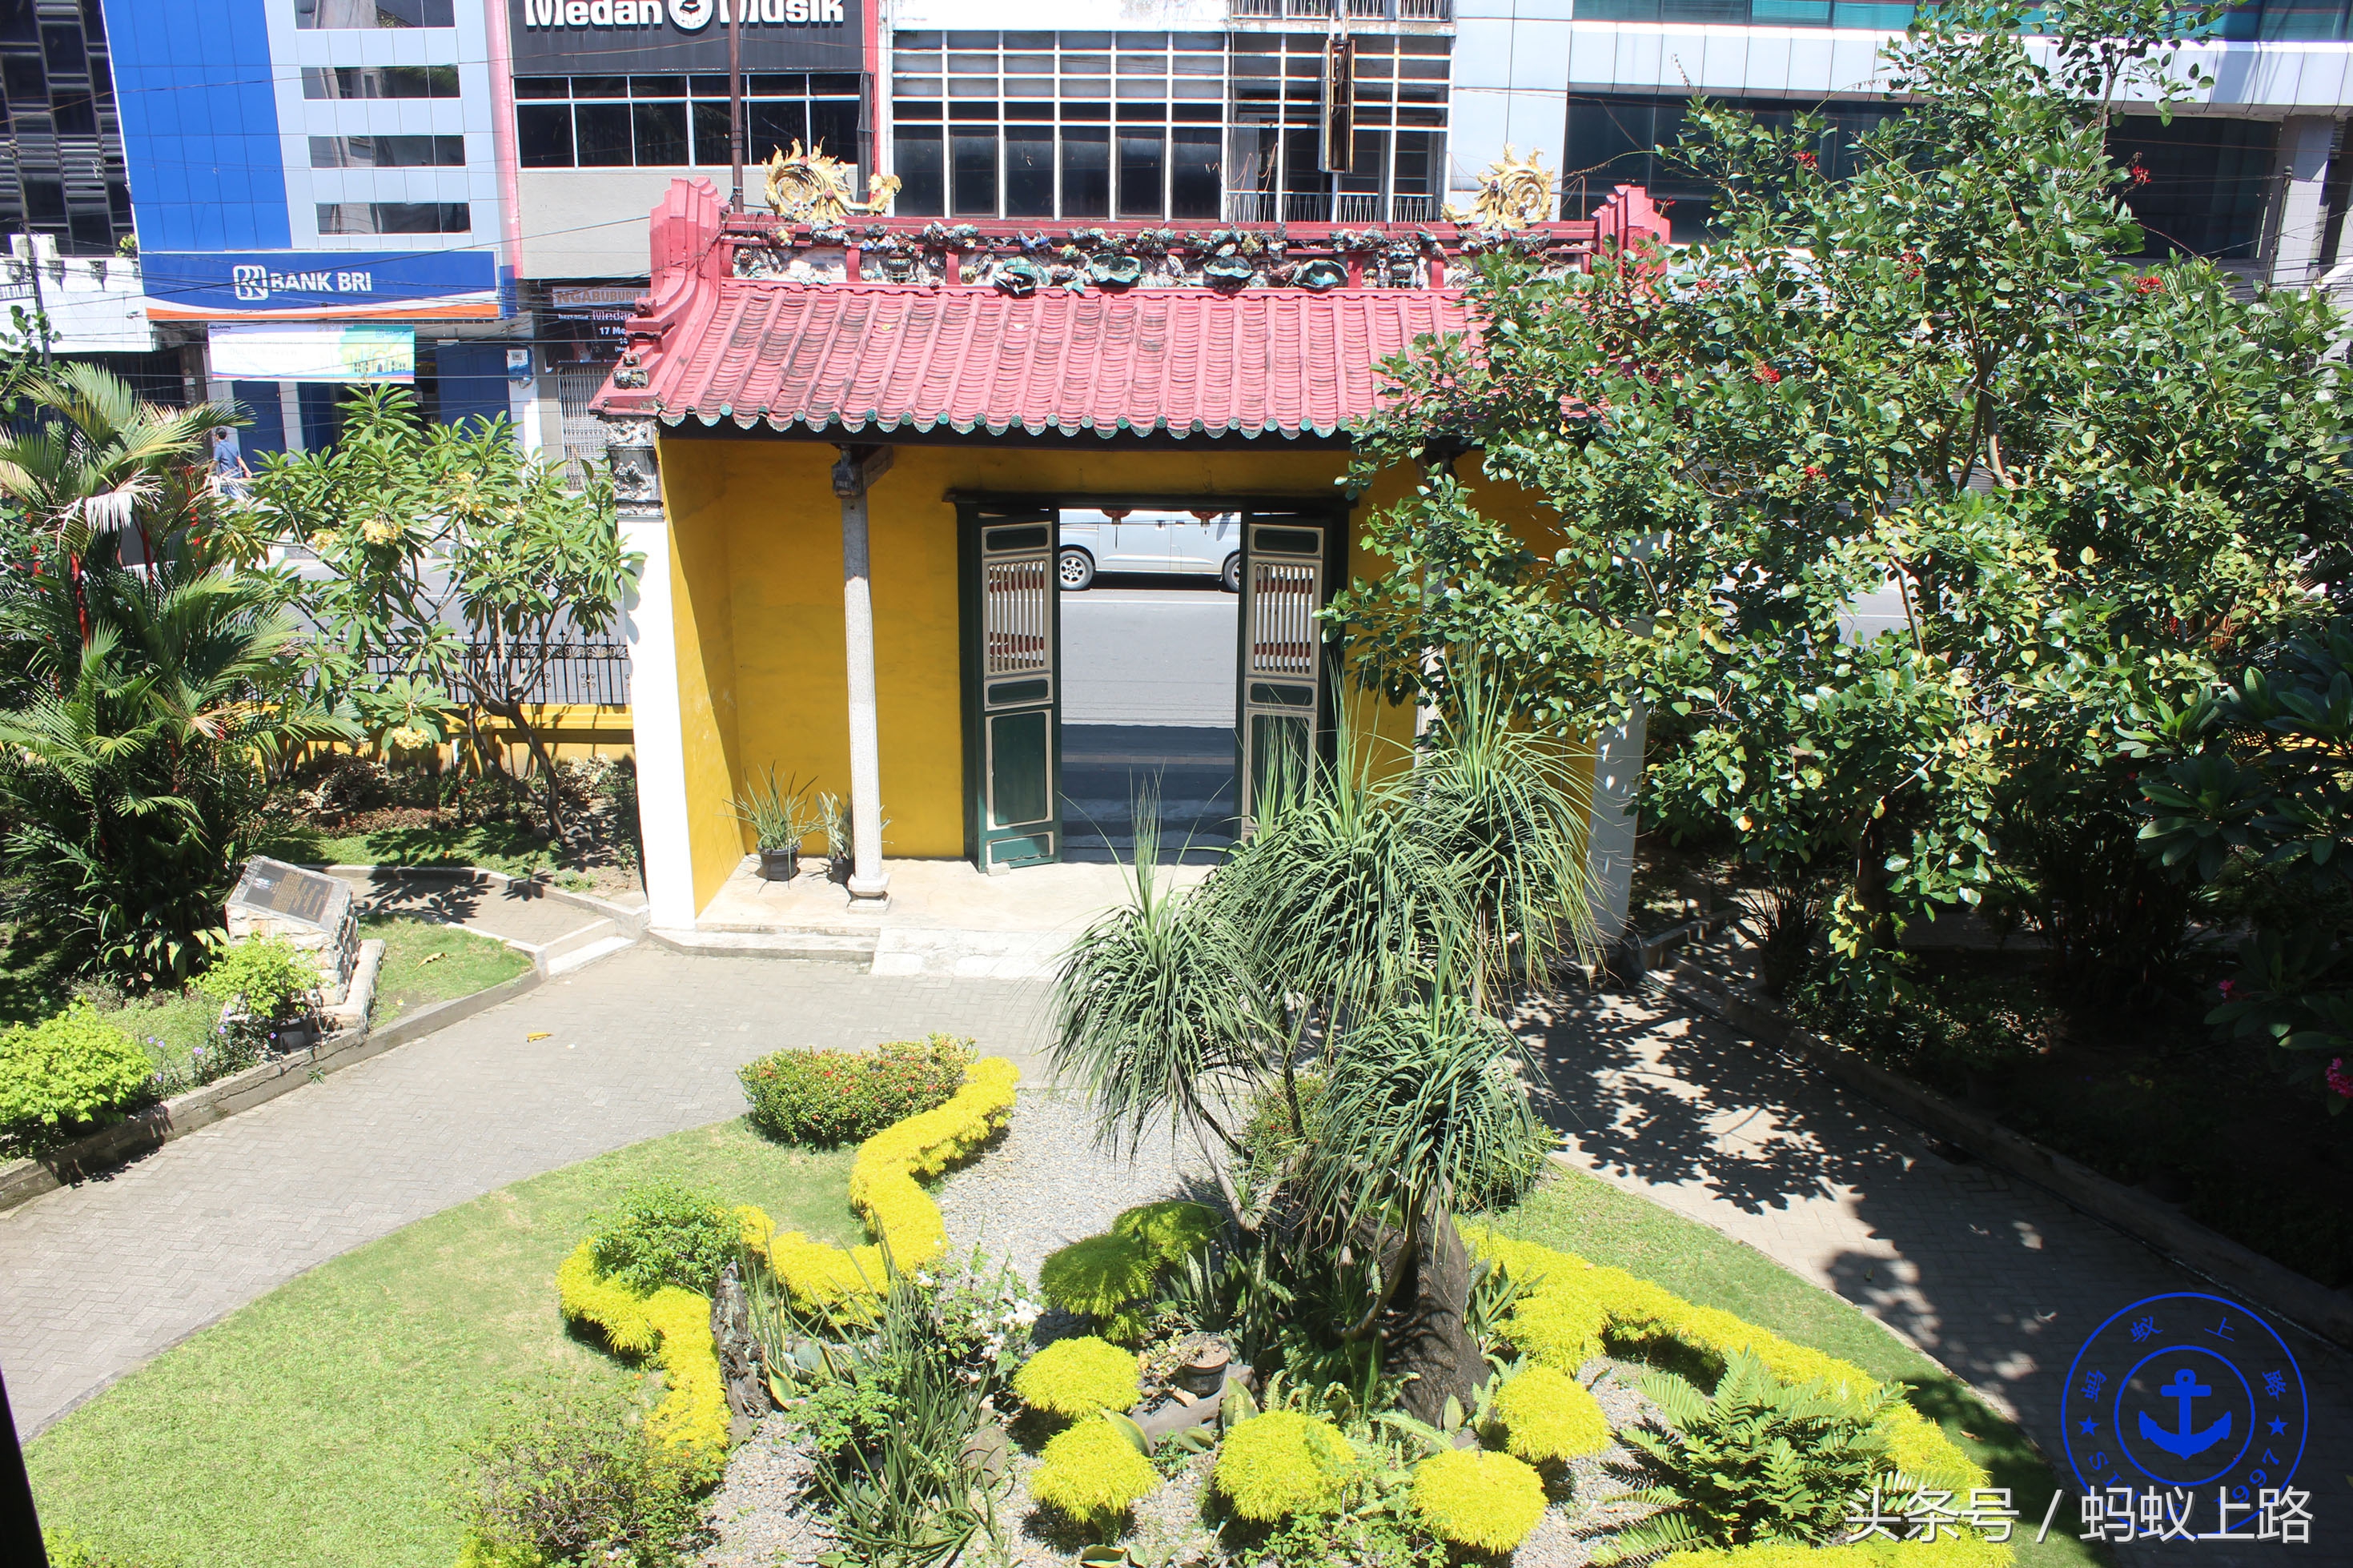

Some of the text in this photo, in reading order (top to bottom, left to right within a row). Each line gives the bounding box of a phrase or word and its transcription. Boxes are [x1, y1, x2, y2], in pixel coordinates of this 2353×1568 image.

[524, 0, 844, 26] Medan Musik
[270, 272, 373, 292] BANK BRI
[599, 327, 610, 335] 17
